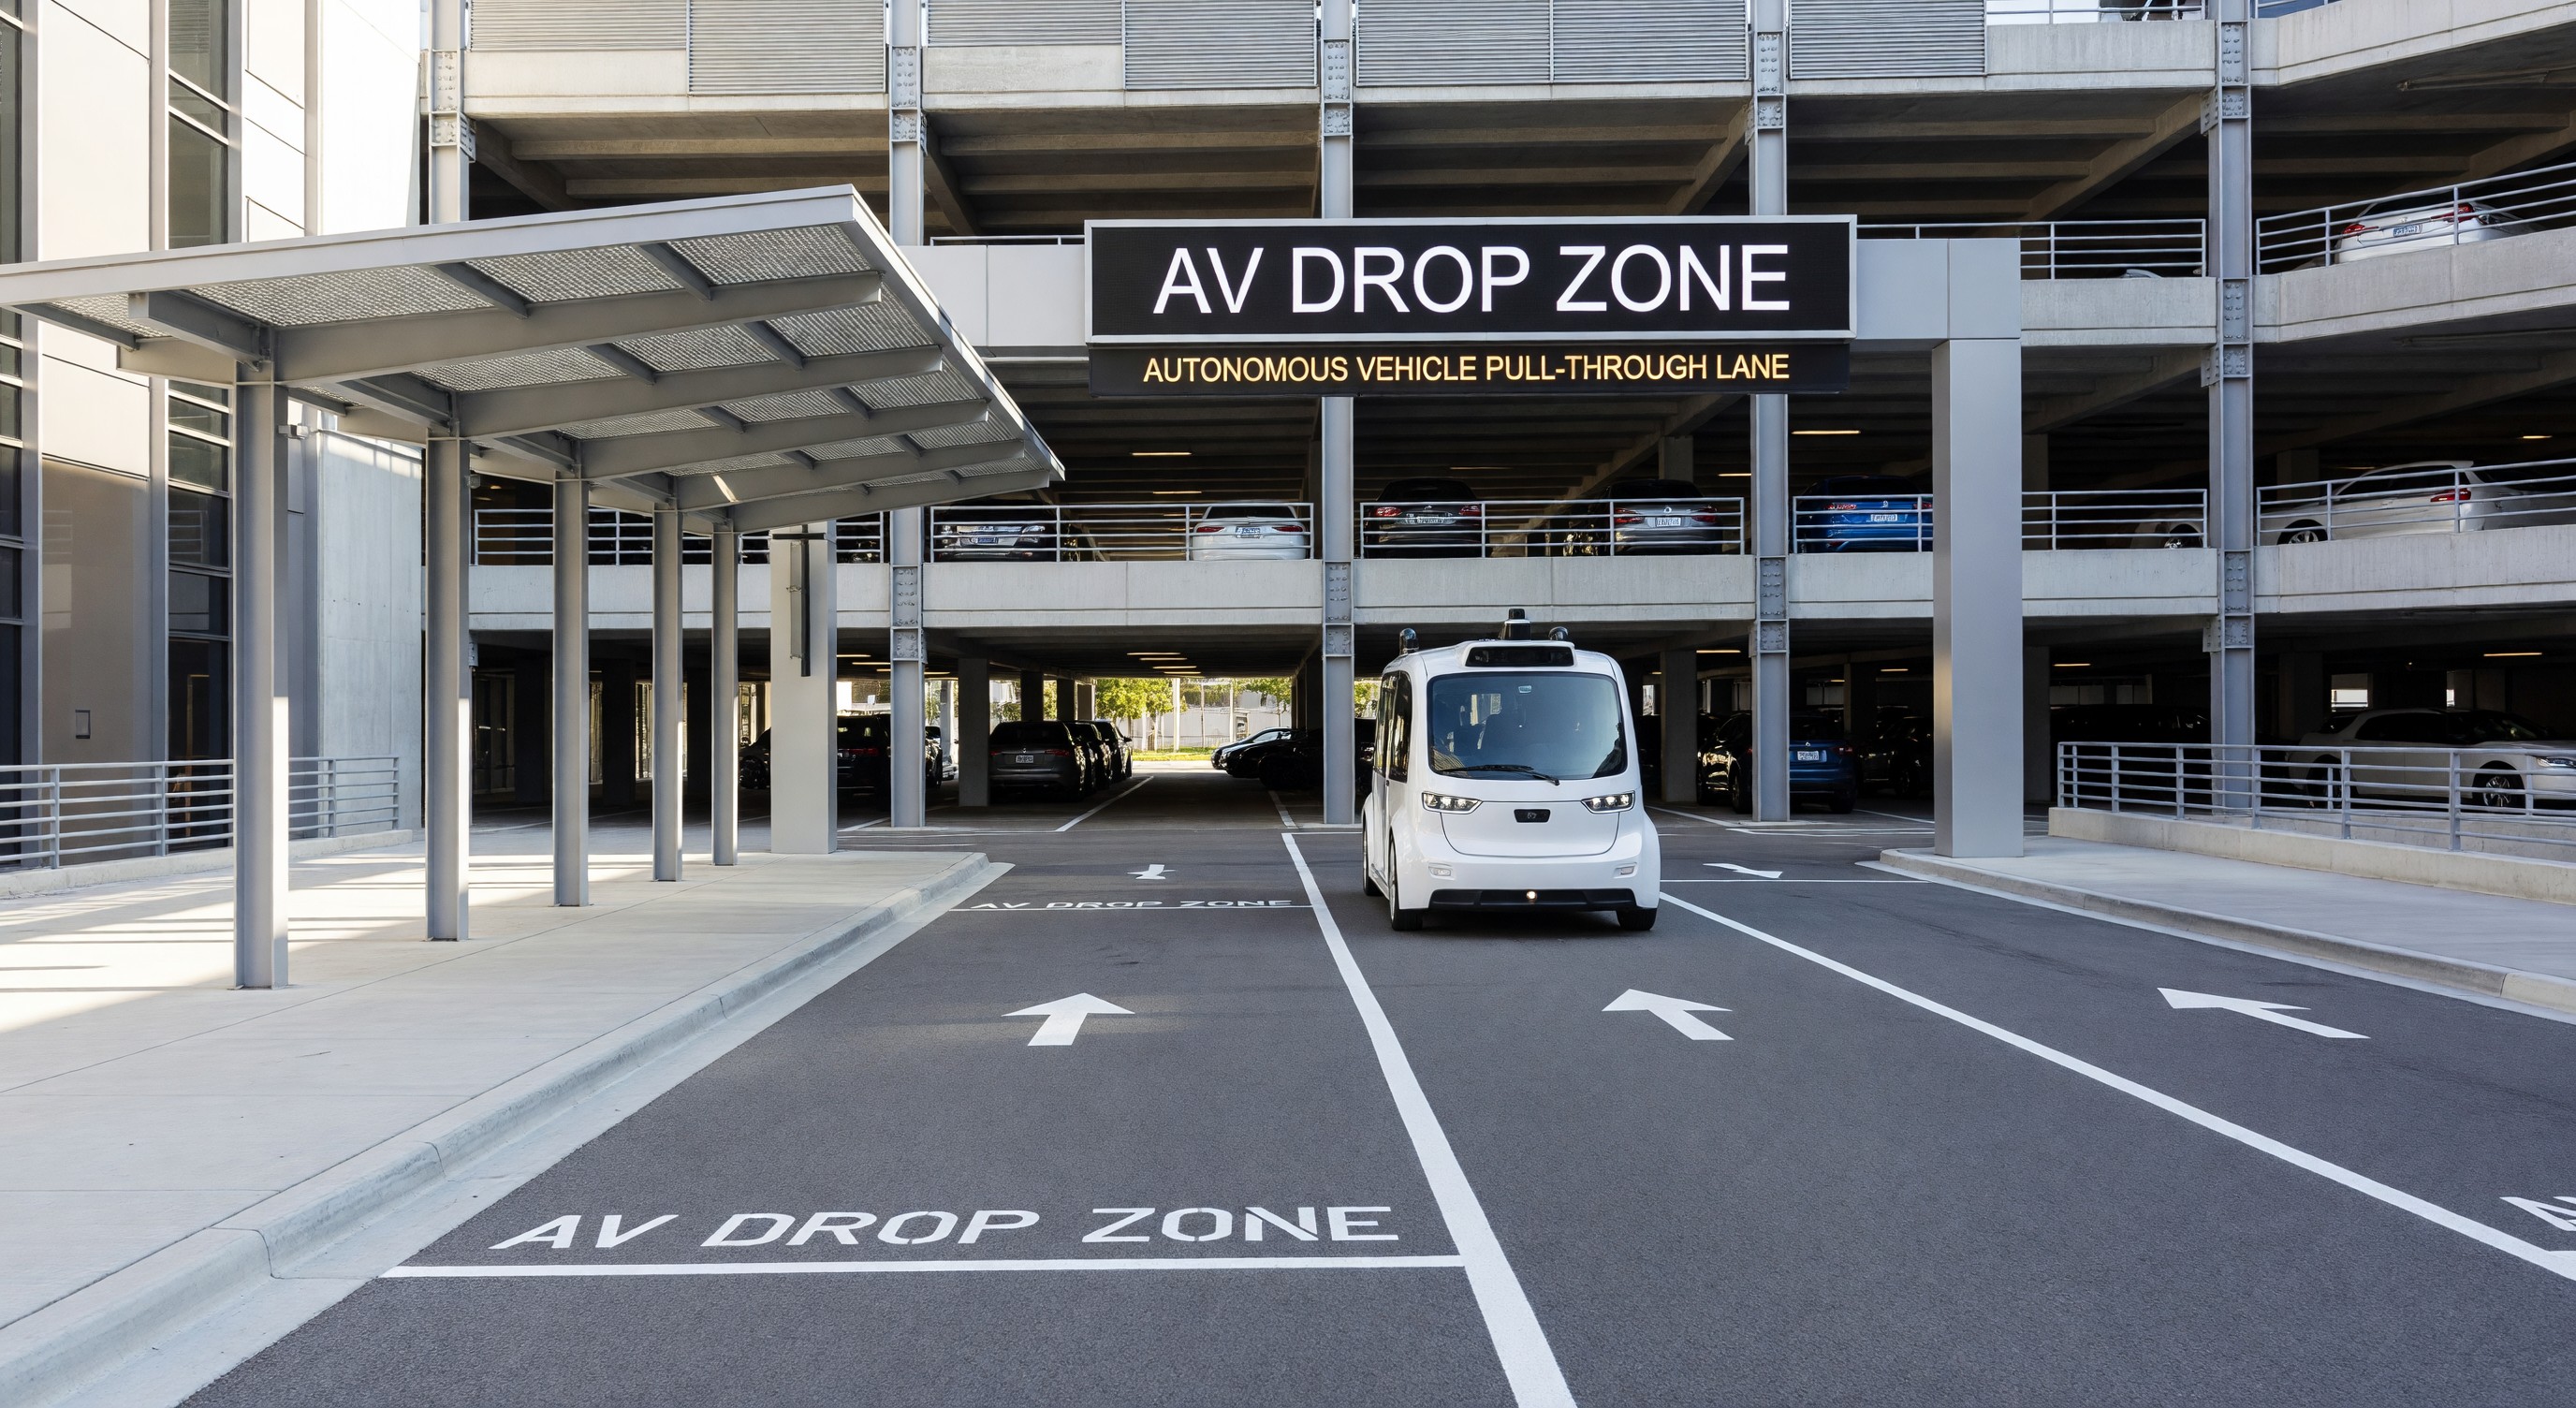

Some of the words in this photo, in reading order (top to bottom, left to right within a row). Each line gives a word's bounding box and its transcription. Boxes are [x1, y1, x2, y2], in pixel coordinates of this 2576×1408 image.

[1153, 247, 1264, 315] AV
[1292, 245, 1530, 314] DROP
[1556, 243, 1790, 312] ZONE
[1143, 356, 1349, 383] AUTONOMOUS
[1355, 355, 1477, 382] VEHICLE
[1486, 354, 1707, 381] PULL-THROUGH
[1717, 353, 1790, 379] LANE
[1046, 901, 1163, 909] DROP
[489, 1213, 680, 1250] AV
[699, 1210, 1040, 1247] DROP
[1081, 1206, 1399, 1243] ZONE
